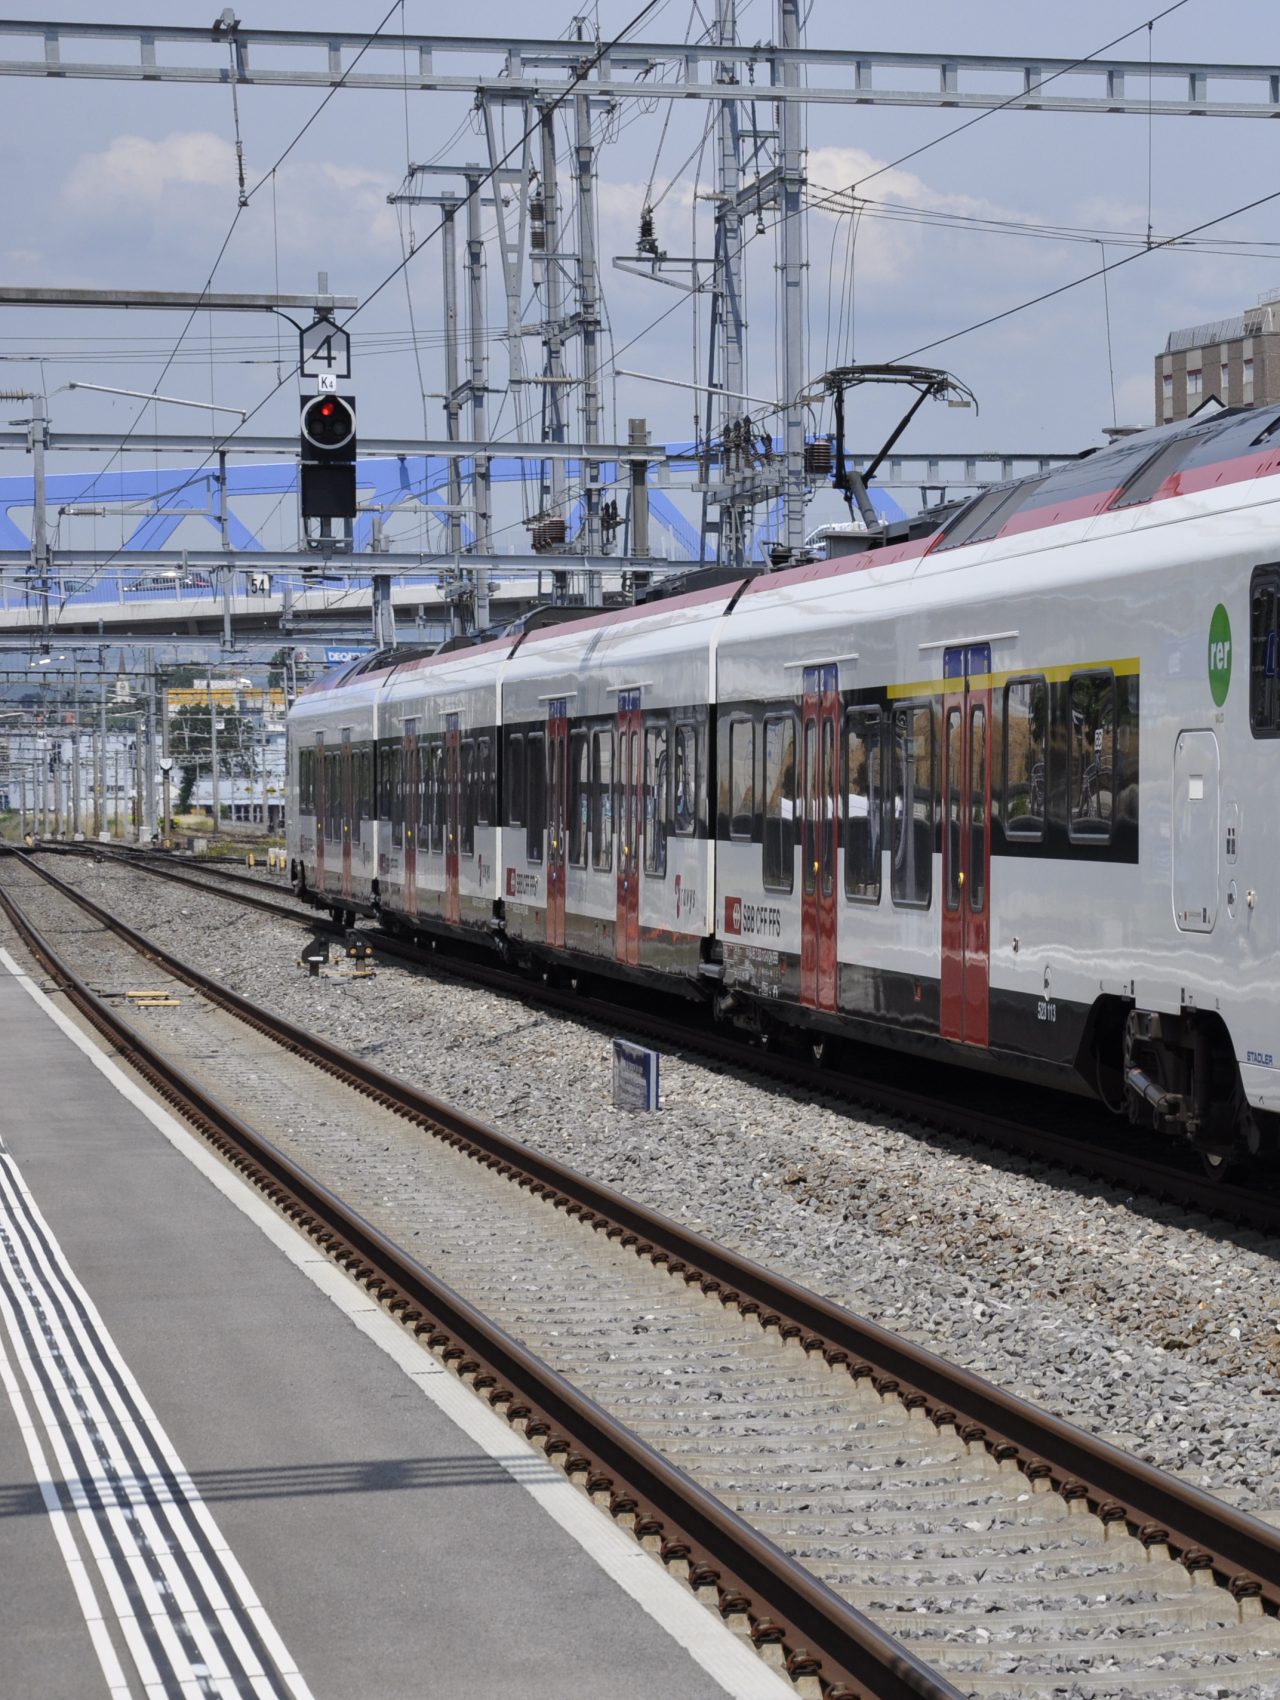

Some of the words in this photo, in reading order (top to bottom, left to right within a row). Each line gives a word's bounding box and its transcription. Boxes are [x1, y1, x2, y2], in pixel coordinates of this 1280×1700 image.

[312, 335, 337, 368] 4
[251, 578, 265, 594] 54
[1210, 641, 1230, 670] rer
[743, 903, 755, 933] SBB
[755, 905, 768, 937] CFF
[769, 907, 781, 938] FFS
[1247, 1051, 1274, 1066] STADLER
